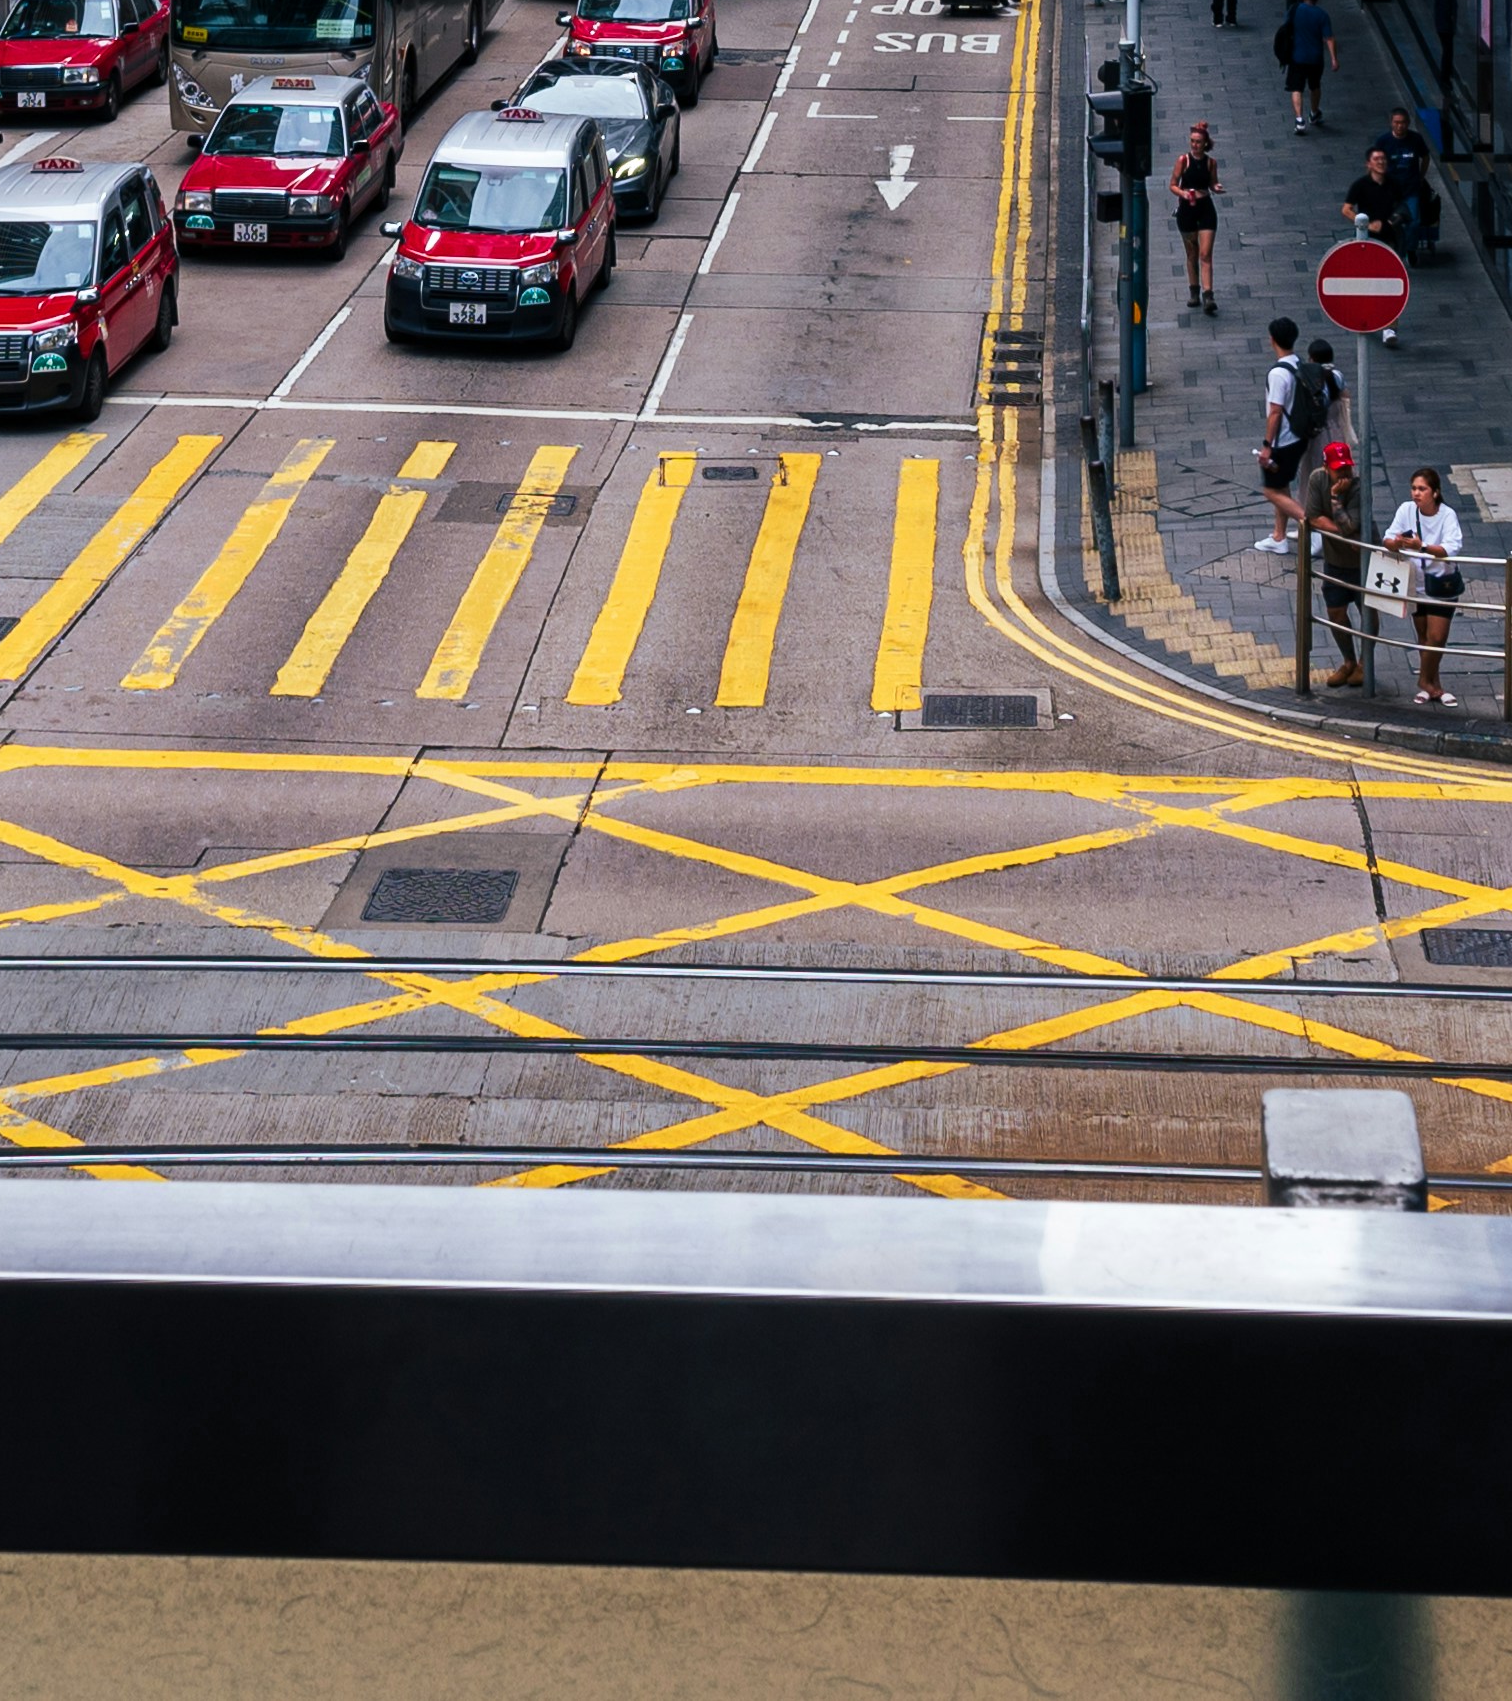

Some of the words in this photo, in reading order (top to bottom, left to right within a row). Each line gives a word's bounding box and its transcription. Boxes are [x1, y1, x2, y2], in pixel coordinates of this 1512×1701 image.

[873, 32, 1002, 54] BUS
[276, 78, 311, 88] TAXI
[503, 109, 537, 119] TAXI
[39, 158, 76, 169] TAXI
[236, 232, 266, 242] 3005
[453, 313, 484, 324] 3284
